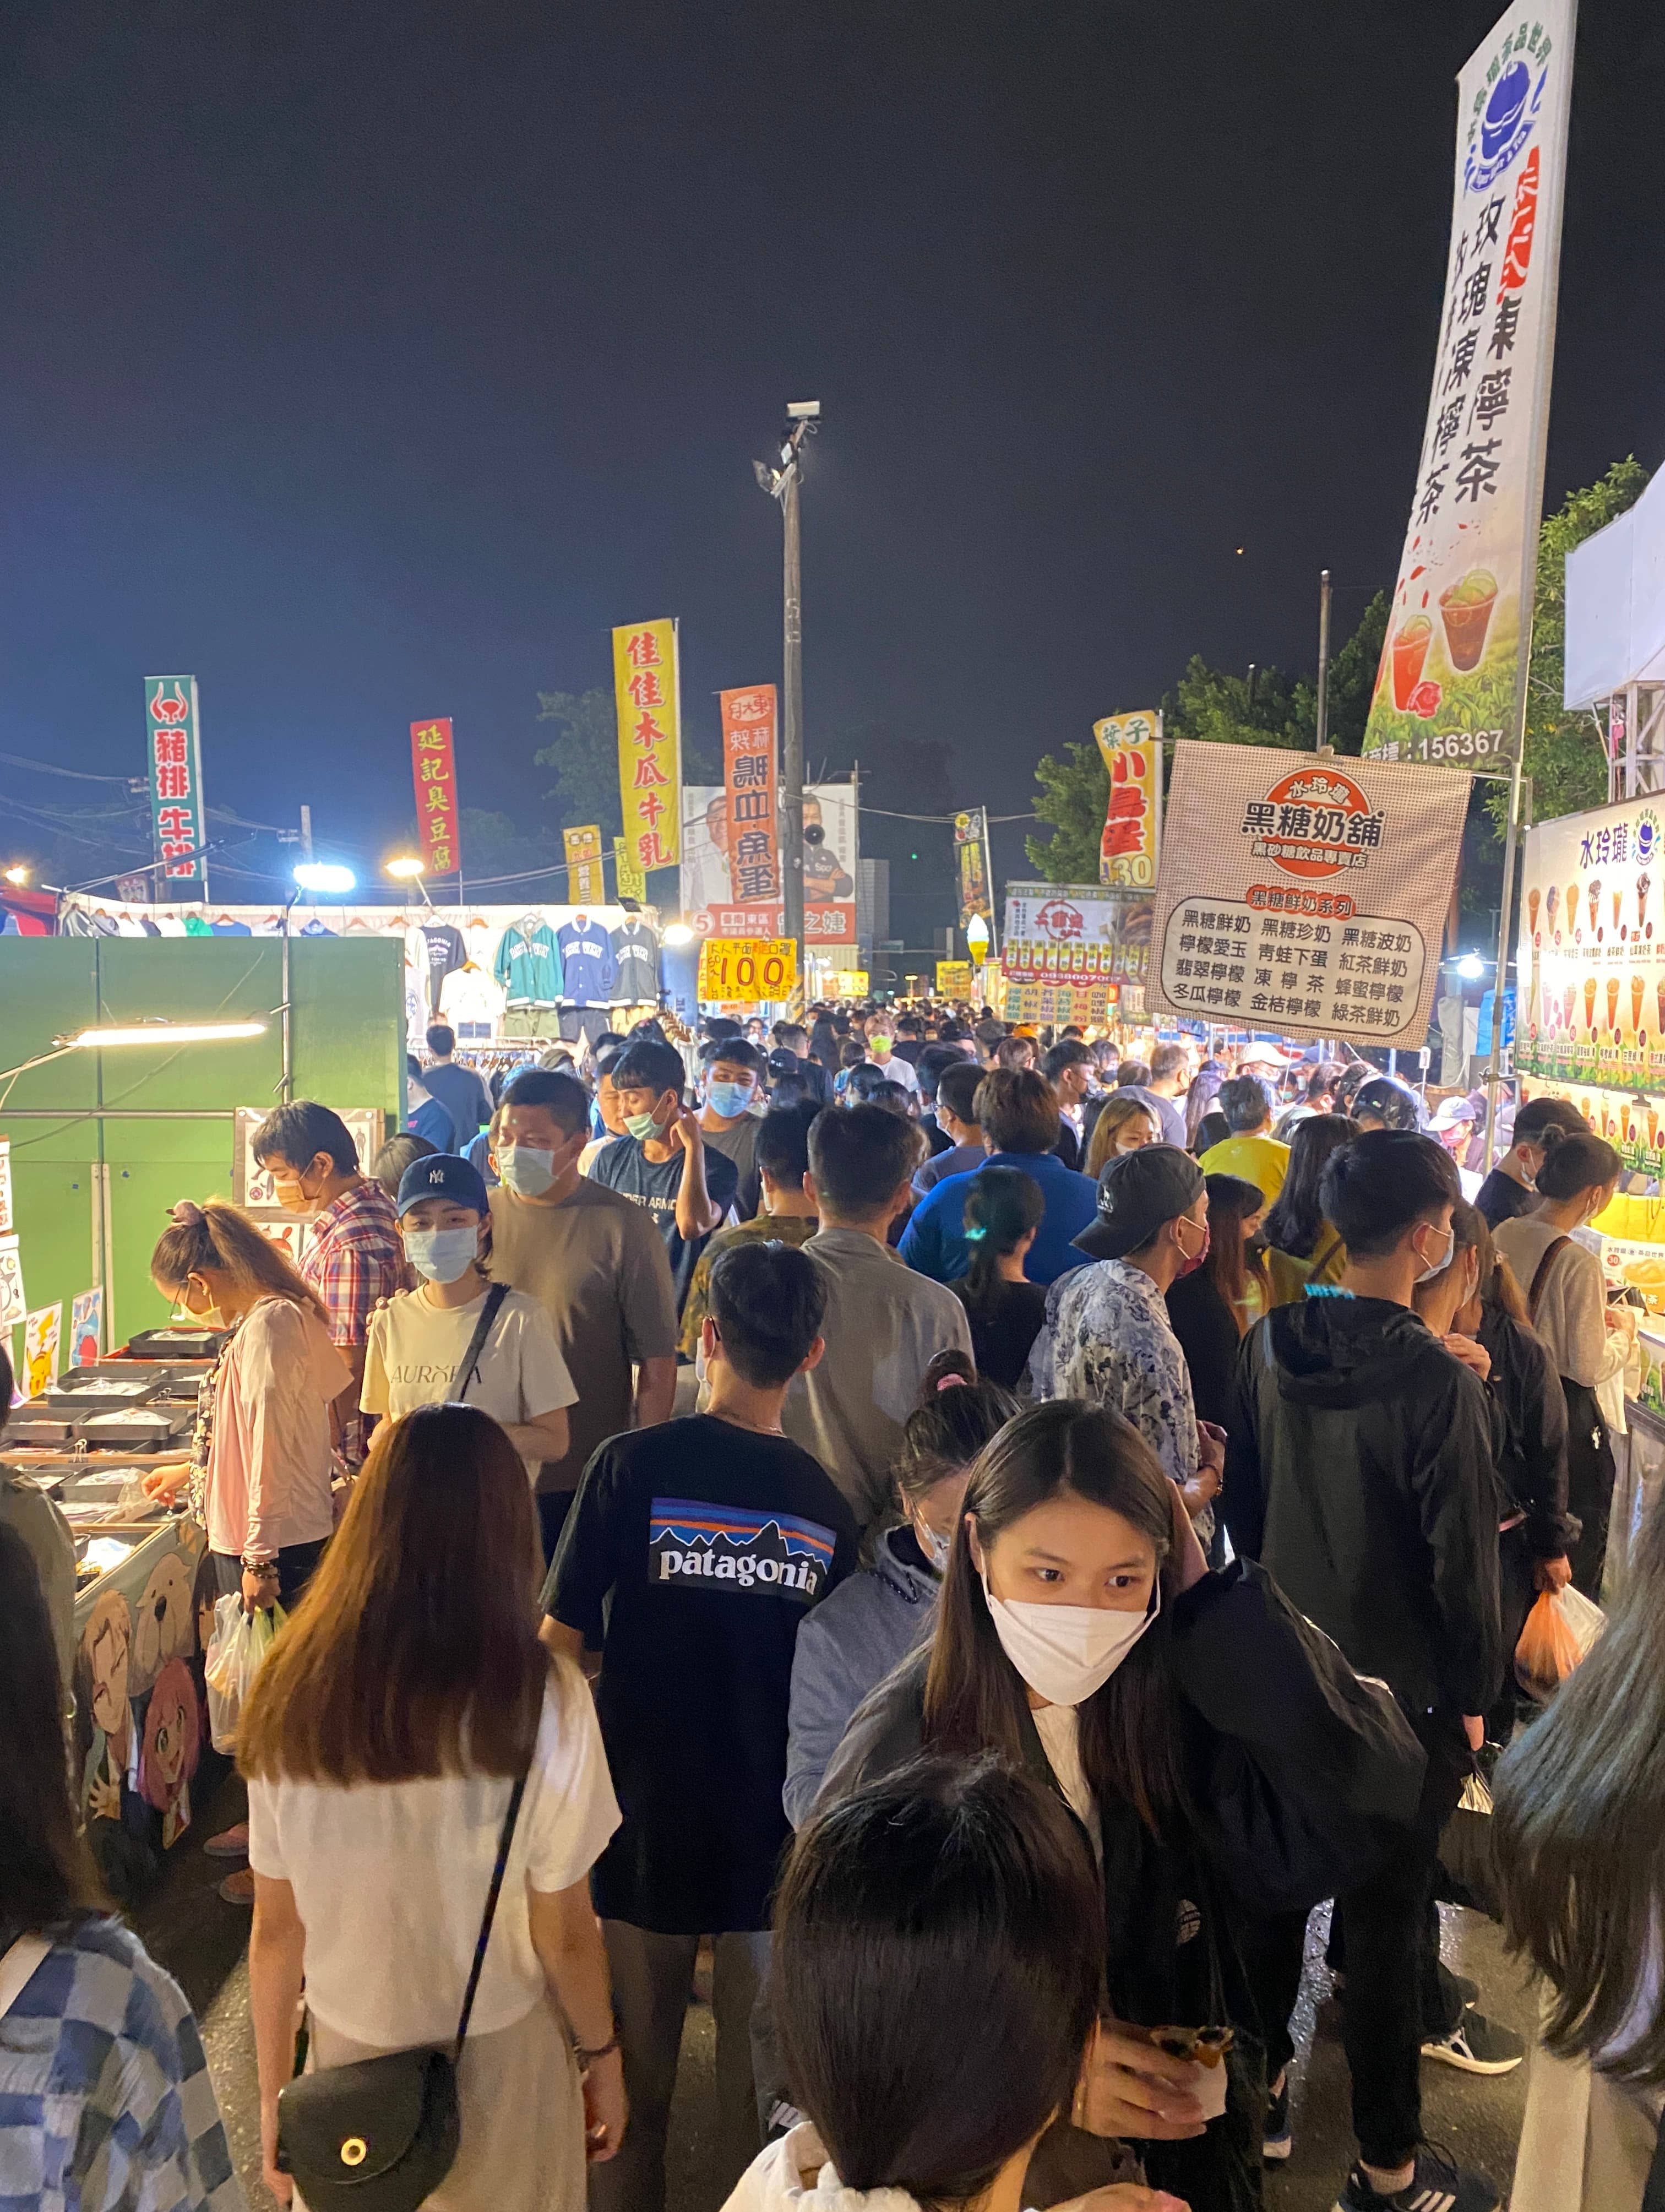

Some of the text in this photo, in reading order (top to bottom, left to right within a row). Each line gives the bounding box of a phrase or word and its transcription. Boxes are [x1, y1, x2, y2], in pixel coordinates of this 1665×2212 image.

[155, 729, 191, 798] 豬排
[626, 631, 673, 869] 佳佳木瓜牛乳
[417, 724, 451, 872] 延記臭豆腐
[1289, 775, 1352, 805] 水玲瓏
[159, 806, 197, 878] 牛排
[1242, 802, 1386, 848] 黑糖奶舖
[1580, 822, 1628, 869] 水玲瓏
[1112, 855, 1152, 885] 30
[1252, 841, 1368, 868] 黑砂糖飲品專賣店
[1252, 889, 1352, 916] 黑糖鮮奶系列
[427, 937, 451, 948] TAGONIA
[1182, 909, 1412, 953] 黑糖鮮奶 黑糖珍奶 黑糖波奶
[721, 957, 784, 986] 100
[1179, 933, 1408, 977] 檸檬愛玉 青蛙下蛋 紅茶鮮奶
[1176, 958, 1403, 1003] 翡翠檸檬 凍檸茶 蜂蜜檸檬
[1173, 983, 1400, 1028] 冬瓜檸檬 金桔檸檬 綠茶鮮奶
[429, 1169, 444, 1184] NY
[1608, 1256, 1619, 1264] 30
[659, 1548, 818, 1595] patagonia
